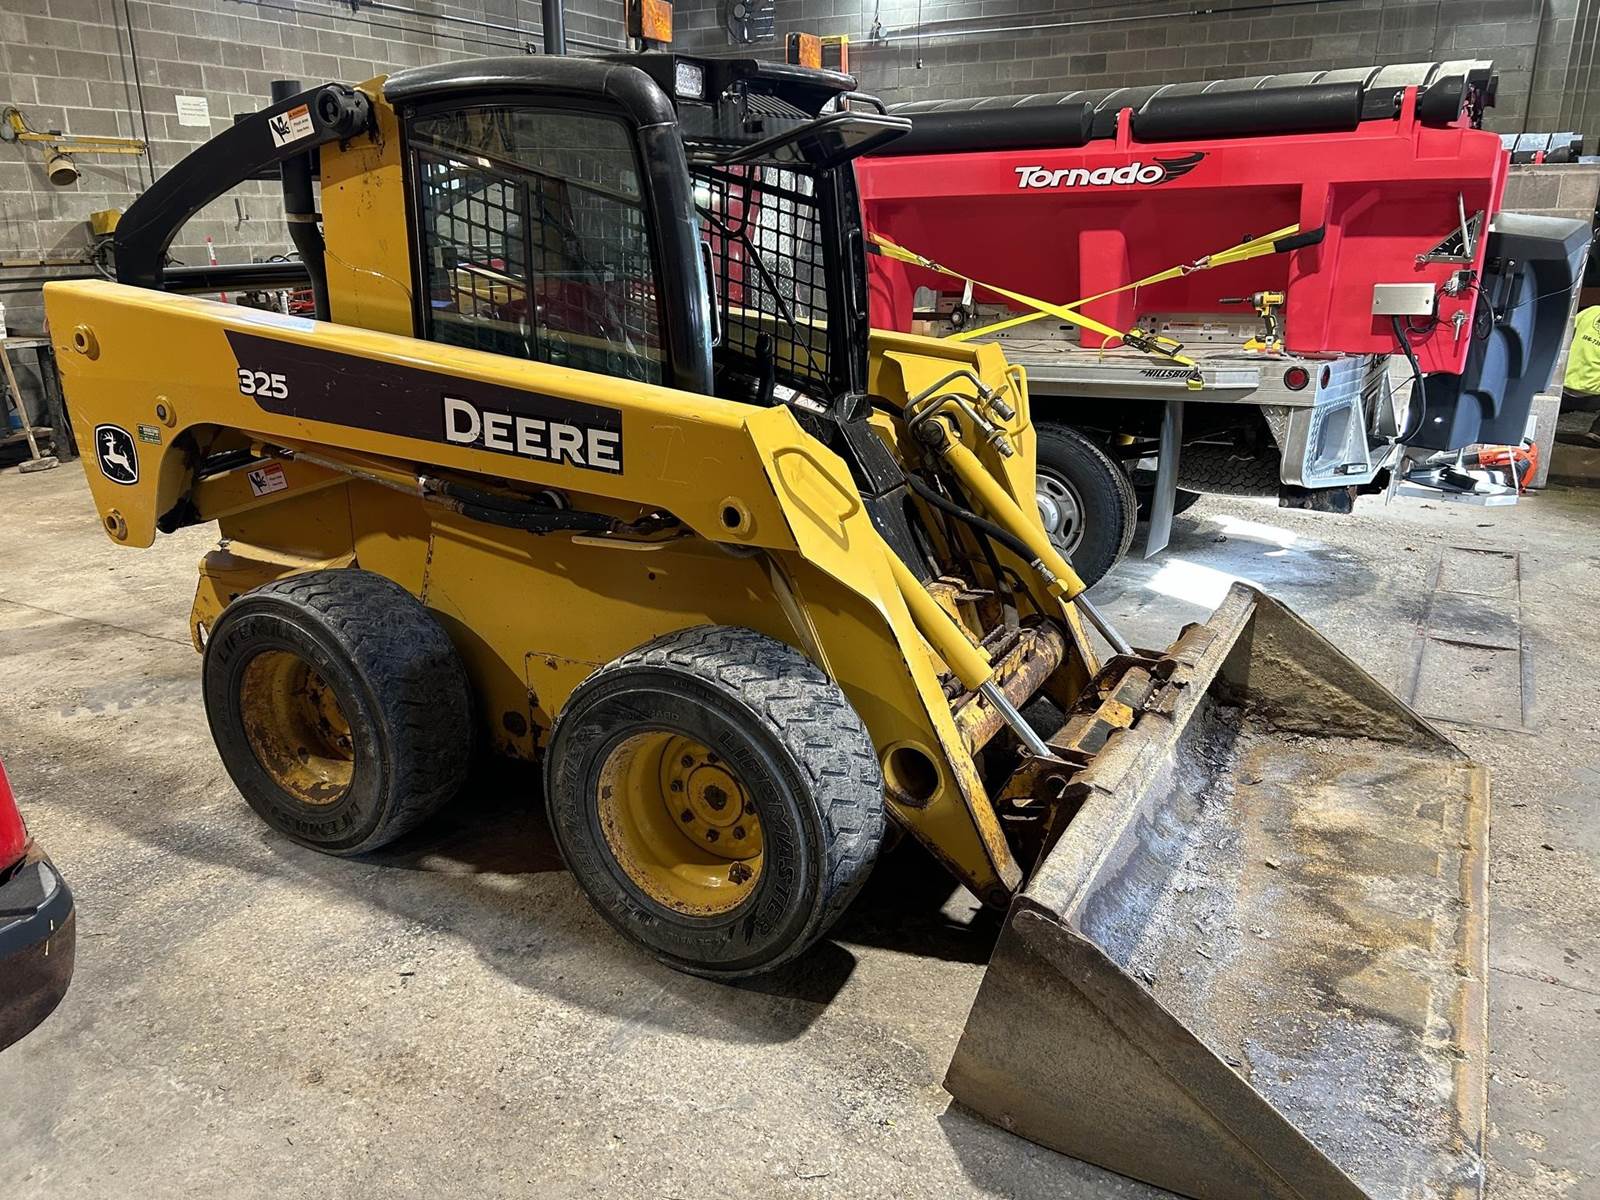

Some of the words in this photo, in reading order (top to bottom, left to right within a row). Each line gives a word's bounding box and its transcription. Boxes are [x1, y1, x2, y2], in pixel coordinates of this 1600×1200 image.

[1014, 160, 1166, 189] Tornado
[238, 369, 288, 399] 325
[444, 397, 620, 470] DEERE
[718, 729, 796, 937] LIFEMASTER
